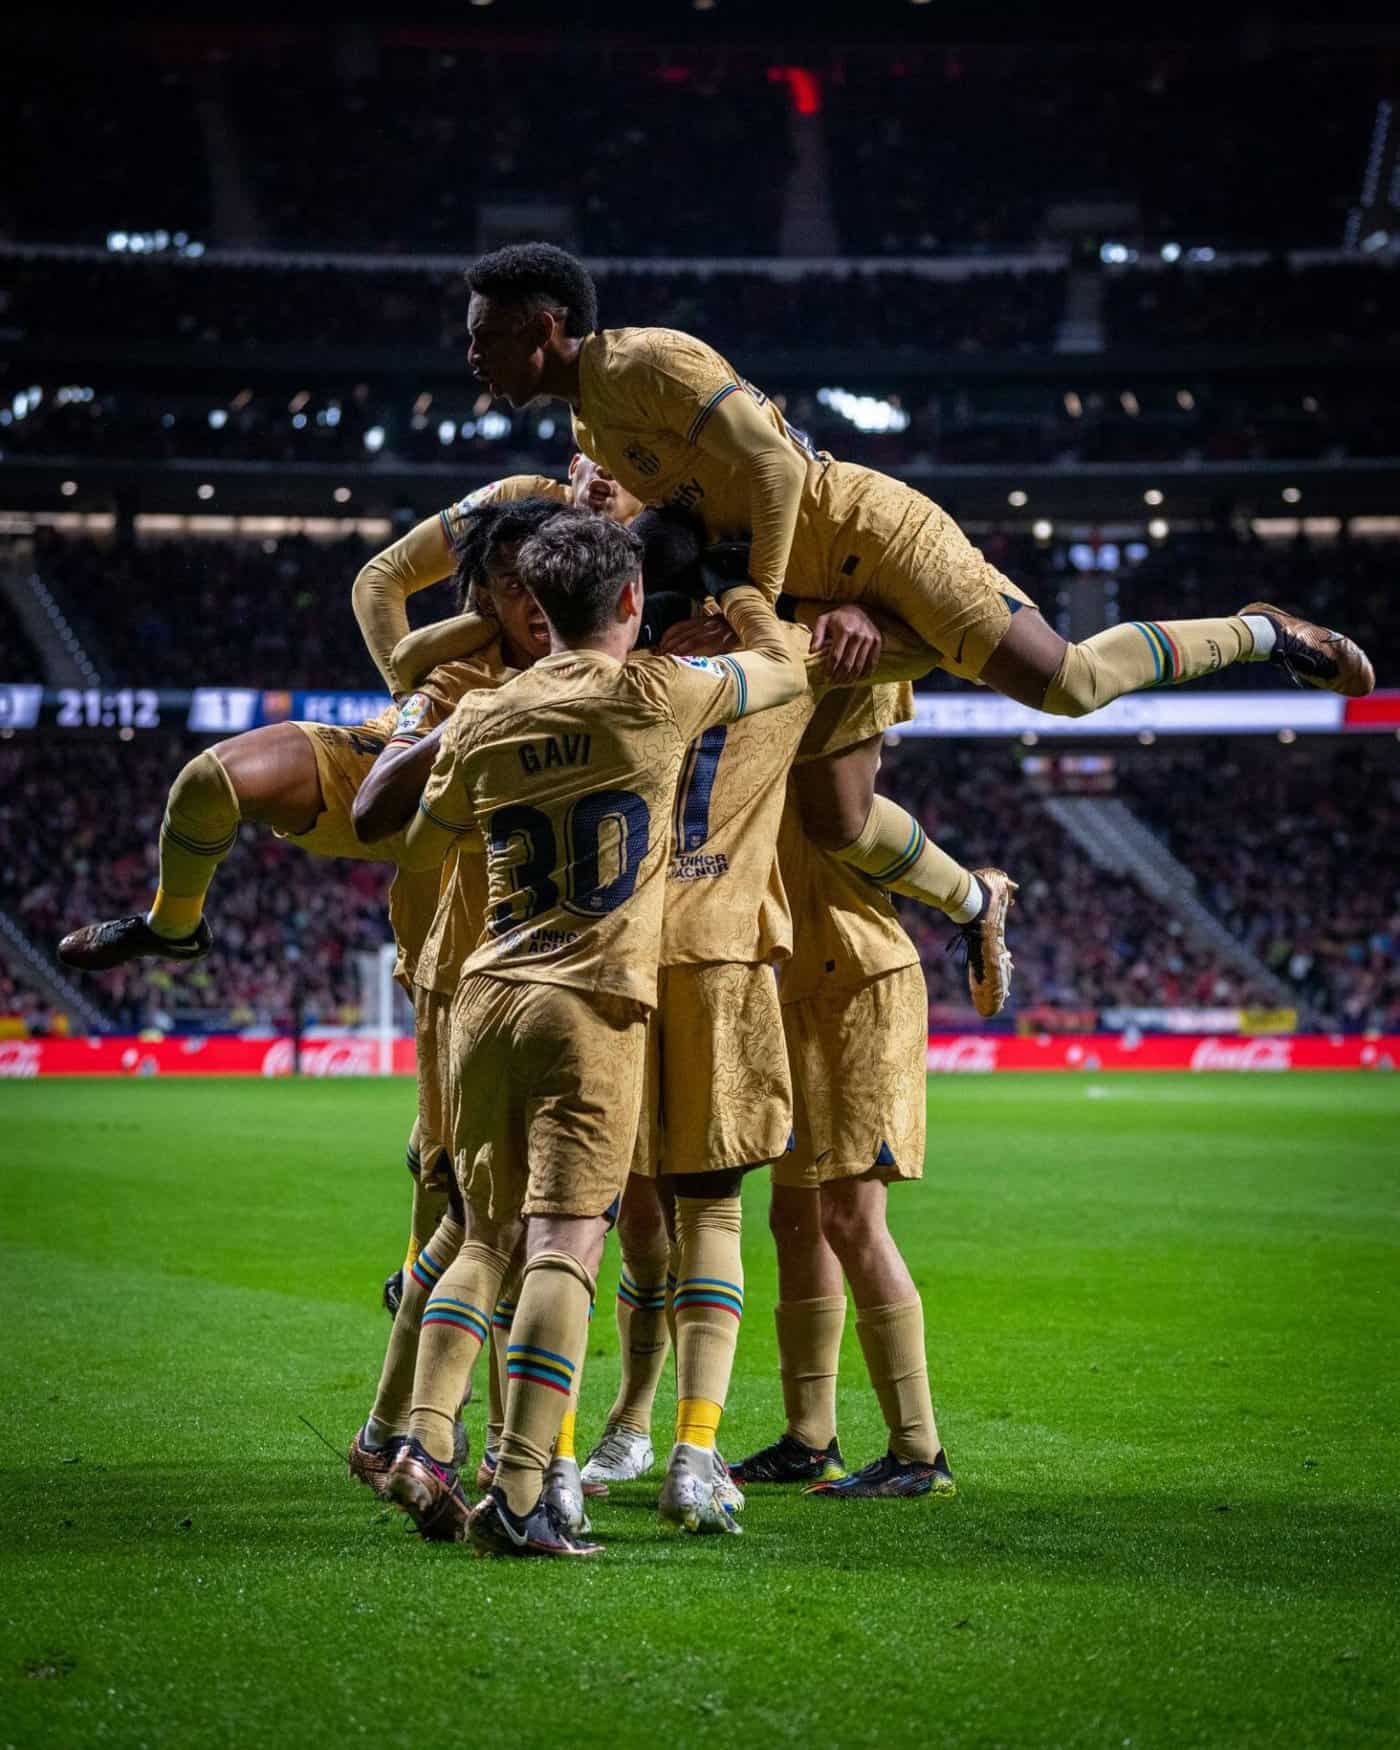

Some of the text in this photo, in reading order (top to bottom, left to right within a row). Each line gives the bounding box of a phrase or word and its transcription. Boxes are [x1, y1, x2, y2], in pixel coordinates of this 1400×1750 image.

[55, 688, 160, 728] 21:12
[518, 733, 592, 777] GAVI
[488, 788, 651, 935] 30
